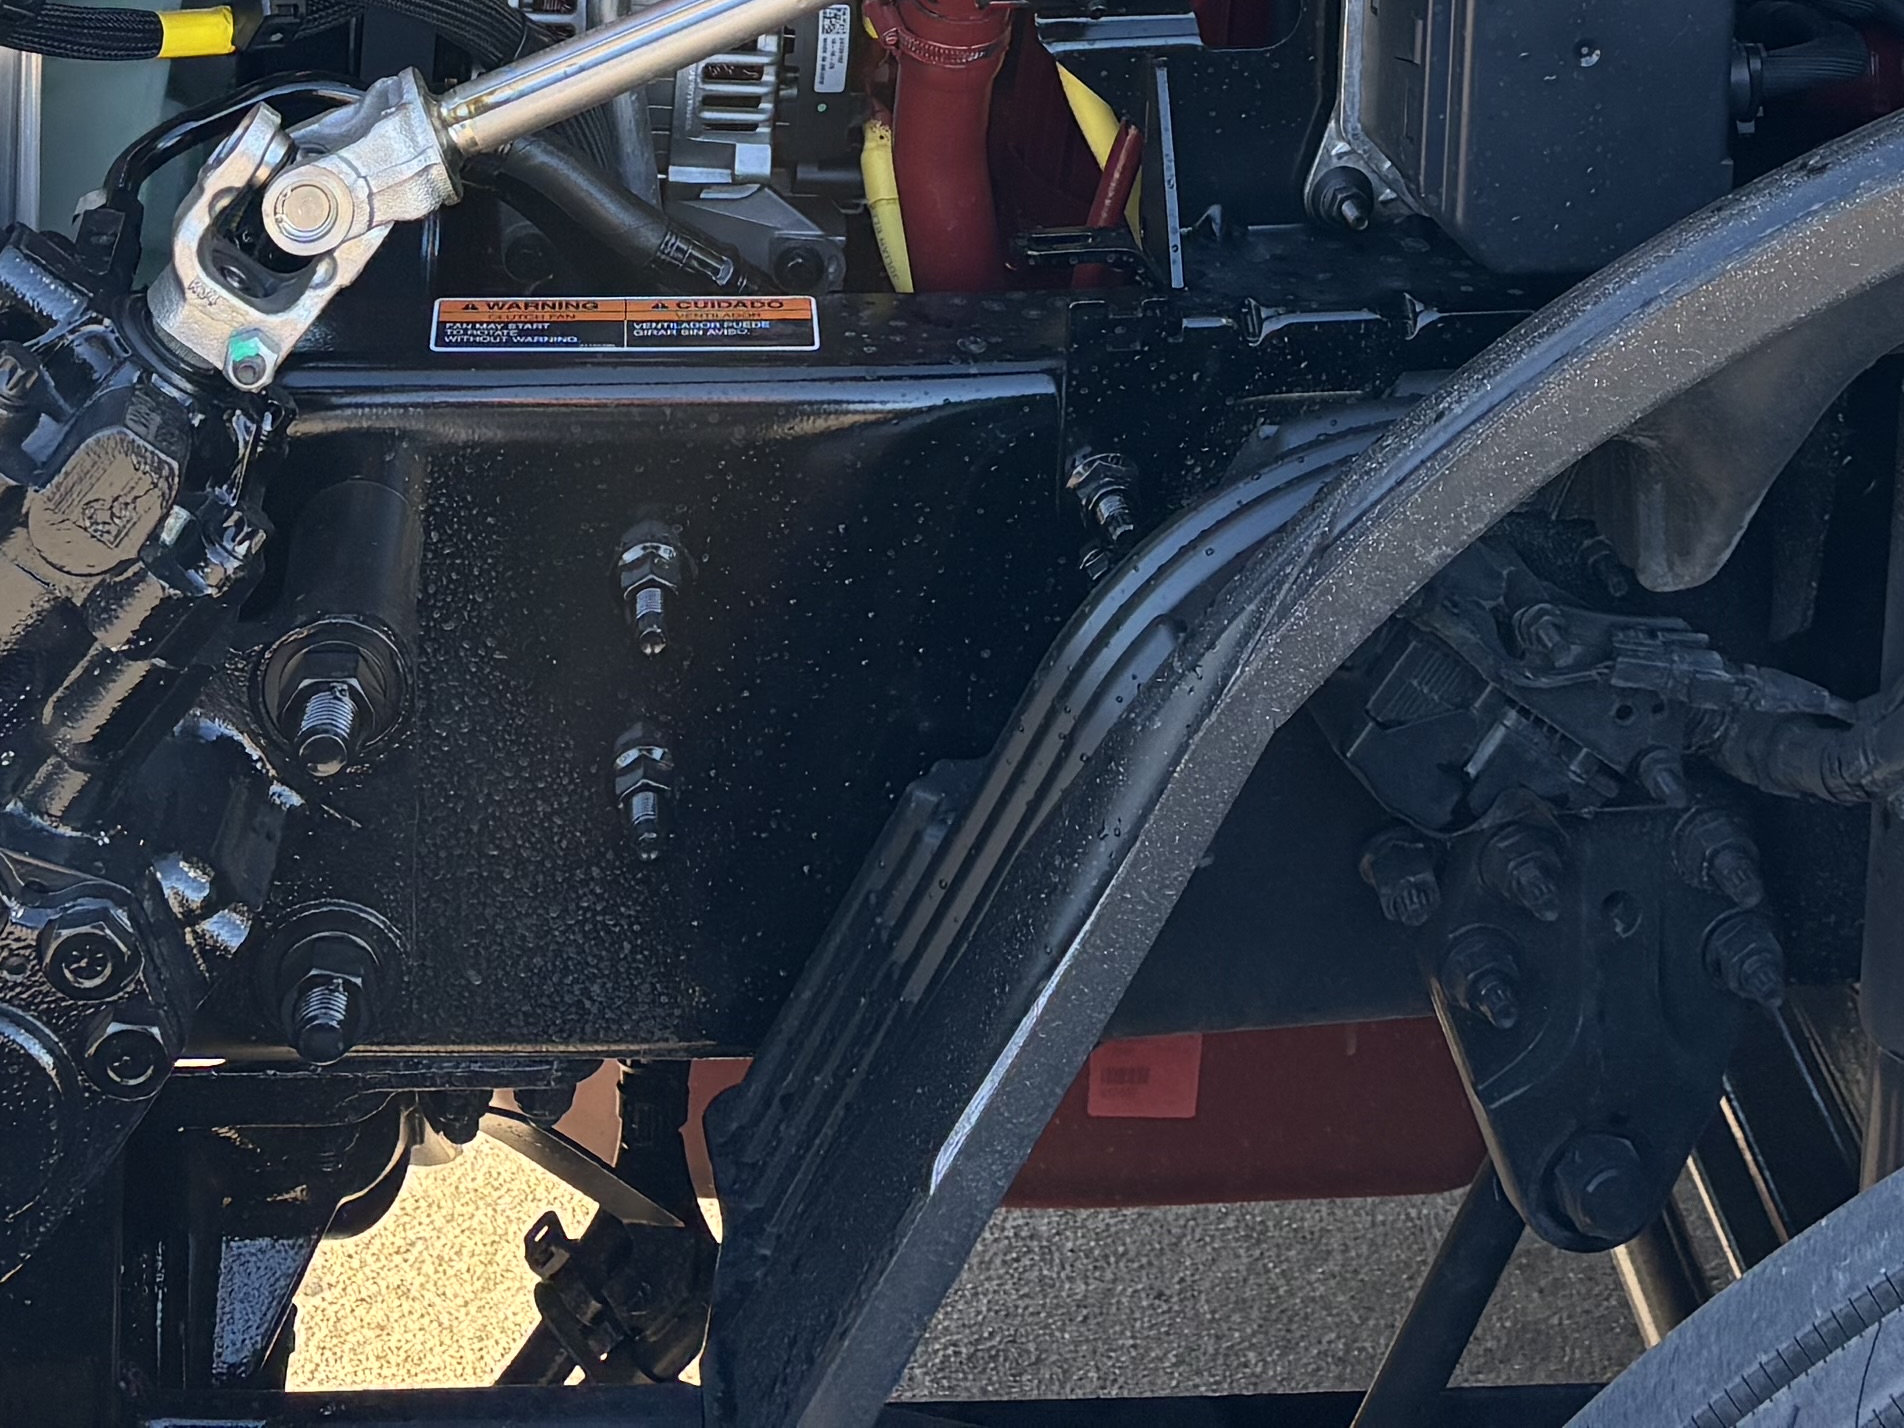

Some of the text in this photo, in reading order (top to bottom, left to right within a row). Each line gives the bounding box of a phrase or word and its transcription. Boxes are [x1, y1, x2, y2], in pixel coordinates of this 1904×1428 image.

[485, 301, 599, 312] WARNING
[676, 299, 784, 310] CUIDADO
[546, 313, 577, 321] FAN
[445, 322, 550, 331] FAN MAY START
[633, 321, 771, 330] VENTILADOR PUEDE
[633, 328, 678, 336] GIRAR
[680, 328, 705, 336] SIN
[444, 335, 512, 343] WITHOUT
